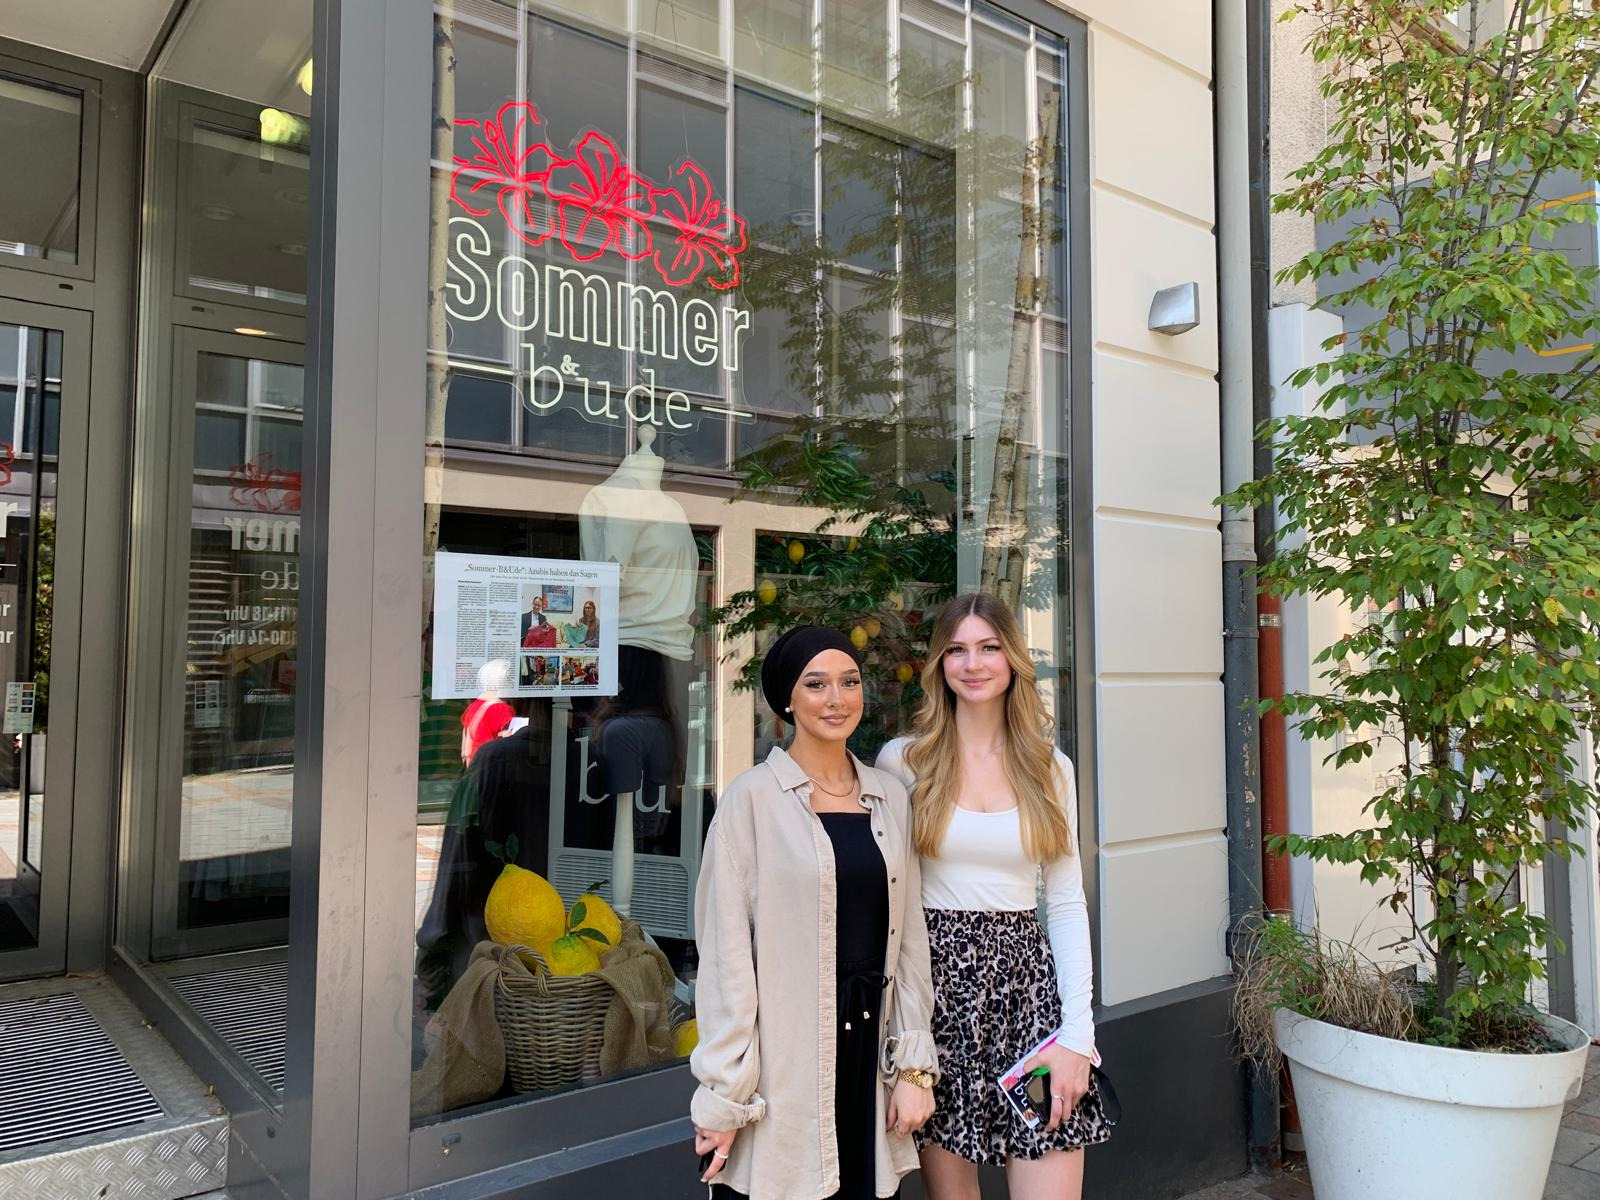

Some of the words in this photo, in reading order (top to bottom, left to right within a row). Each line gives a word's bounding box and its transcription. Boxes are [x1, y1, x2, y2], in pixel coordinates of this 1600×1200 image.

[446, 216, 750, 372] Sommer
[550, 568, 569, 577] haben
[569, 569, 579, 577] das
[580, 570, 598, 579] Sagen
